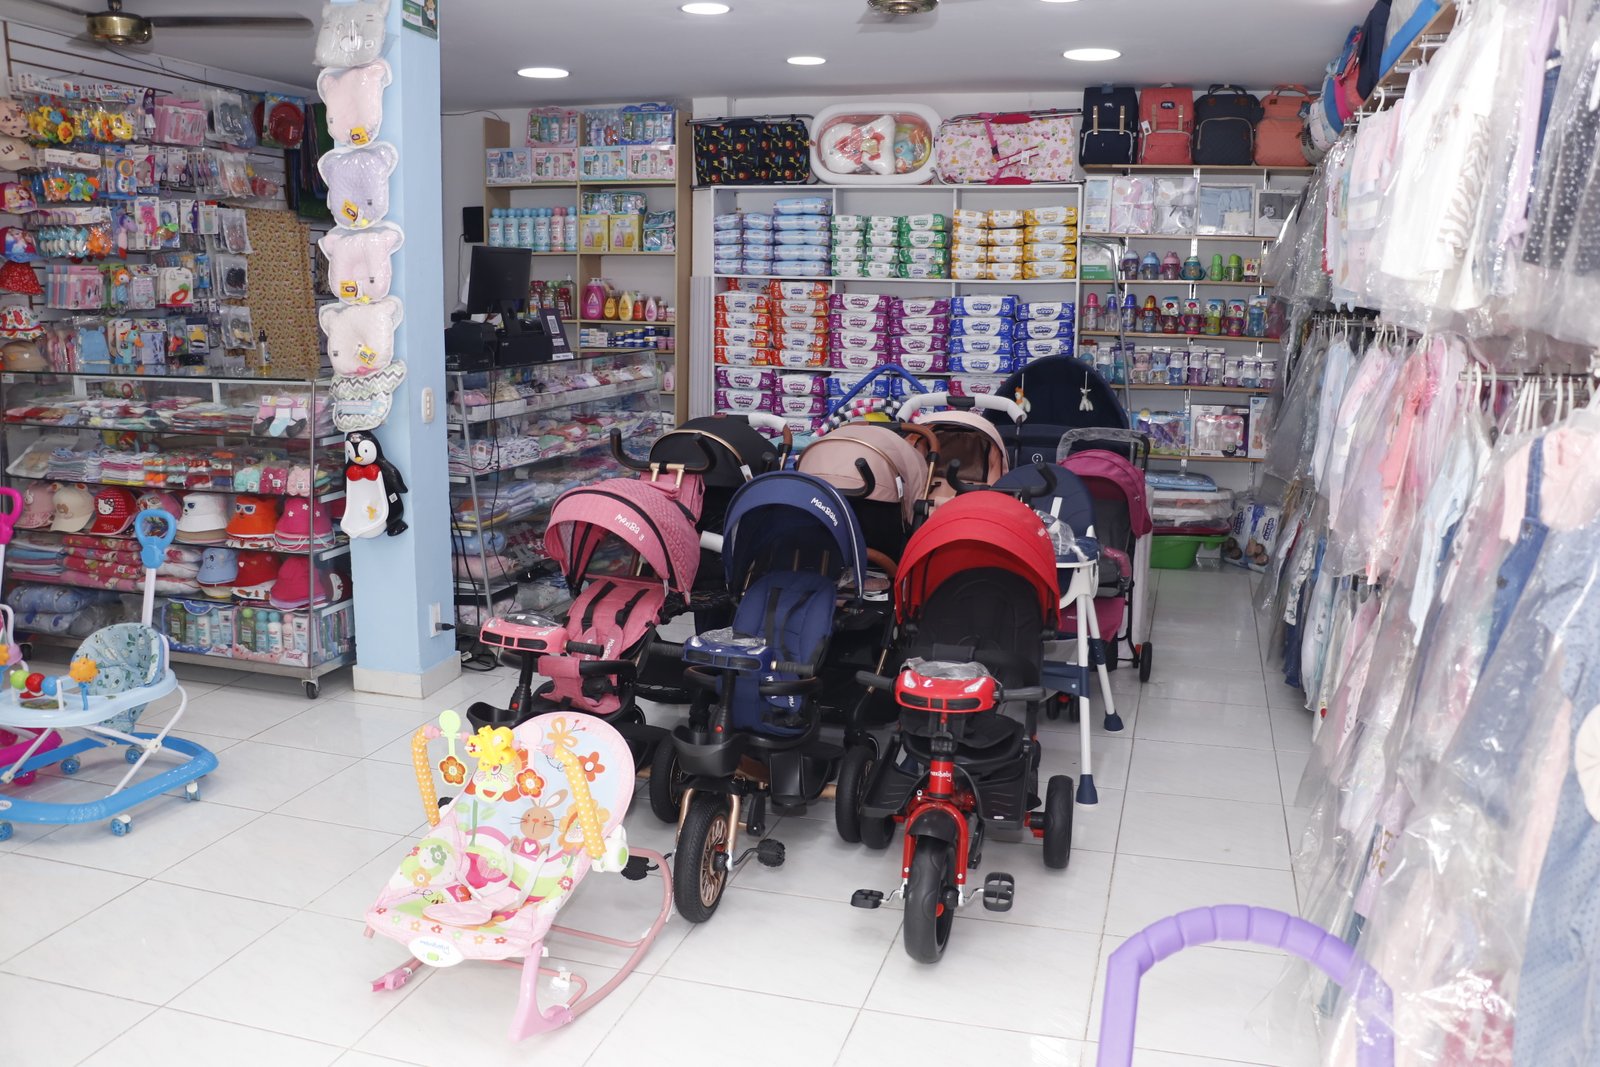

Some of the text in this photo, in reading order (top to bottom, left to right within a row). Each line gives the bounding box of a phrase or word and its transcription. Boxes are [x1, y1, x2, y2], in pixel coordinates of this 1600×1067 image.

[2, 145, 14, 155] LU
[850, 297, 870, 307] winny
[972, 301, 991, 312] winny
[1001, 303, 1010, 311] 30
[1036, 306, 1055, 316] winny
[849, 316, 867, 327] winny
[909, 323, 928, 332] winny
[971, 322, 990, 333] winny
[849, 336, 868, 346] winny
[971, 341, 990, 351] winny
[1034, 344, 1052, 353] winny
[849, 355, 869, 366] winny
[907, 359, 926, 369] winny
[970, 359, 990, 370] winny
[1000, 361, 1009, 369] 30
[733, 375, 754, 386] winny
[789, 382, 807, 393] winny
[734, 395, 754, 407] winny
[788, 400, 806, 410] winny
